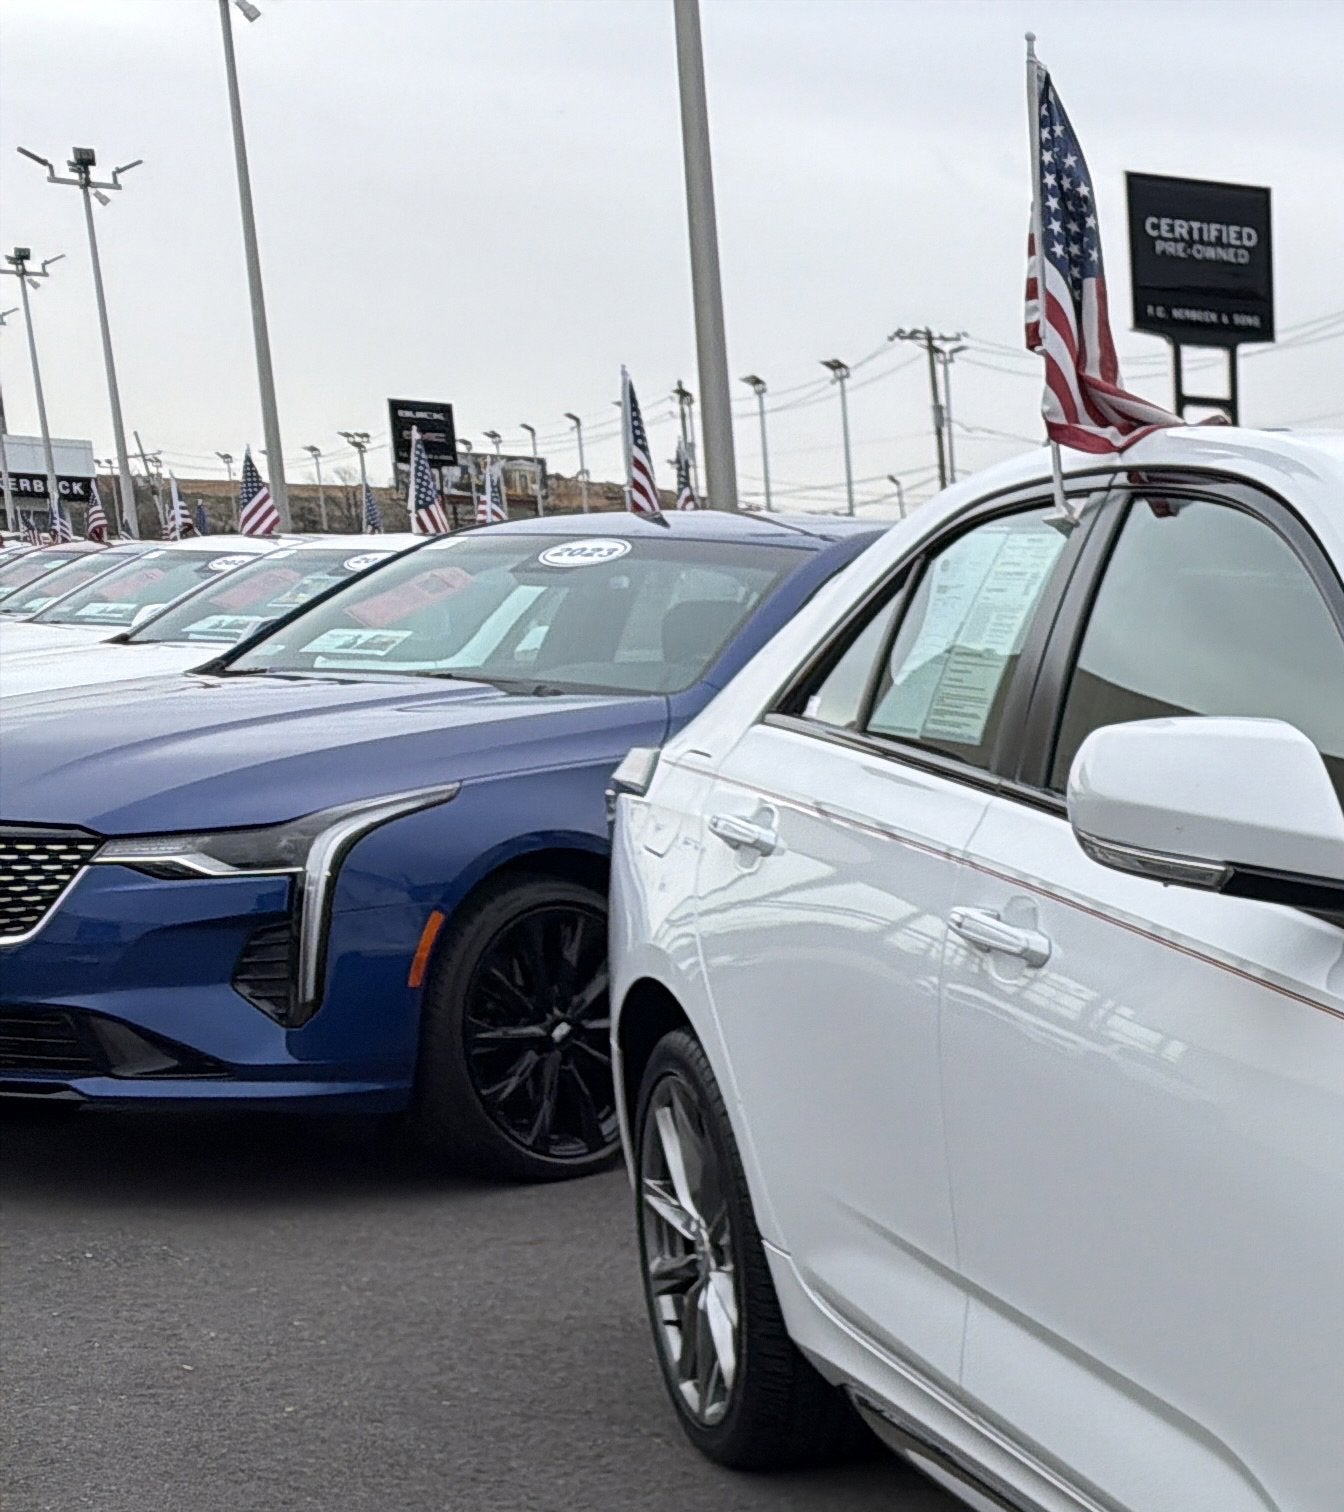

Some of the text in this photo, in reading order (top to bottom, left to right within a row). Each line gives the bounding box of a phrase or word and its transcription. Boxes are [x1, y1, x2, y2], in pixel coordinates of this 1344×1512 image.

[1144, 216, 1258, 247] CERTIFIED
[1155, 240, 1250, 265] PRE-OWNED
[550, 546, 619, 558] 2023
